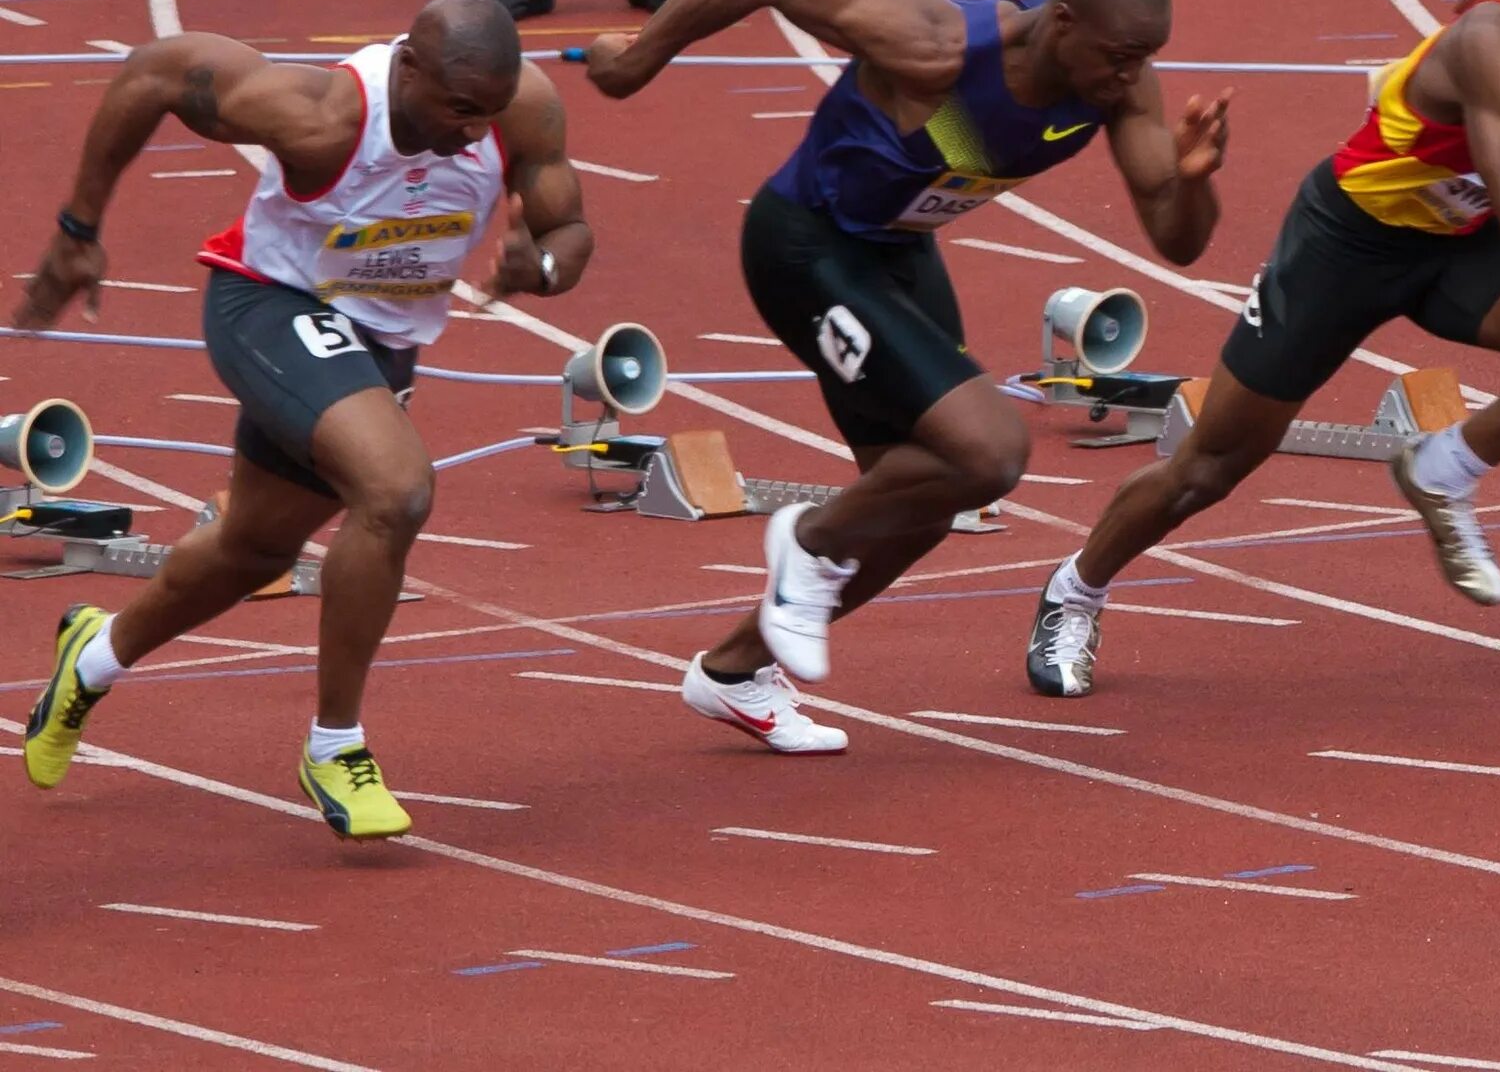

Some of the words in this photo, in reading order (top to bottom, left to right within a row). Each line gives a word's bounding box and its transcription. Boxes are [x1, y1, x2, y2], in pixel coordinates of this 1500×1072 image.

[371, 221, 462, 243] AVIVA
[365, 247, 422, 268] LEWIS
[346, 264, 429, 280] FRANCIS
[310, 313, 352, 351] 5
